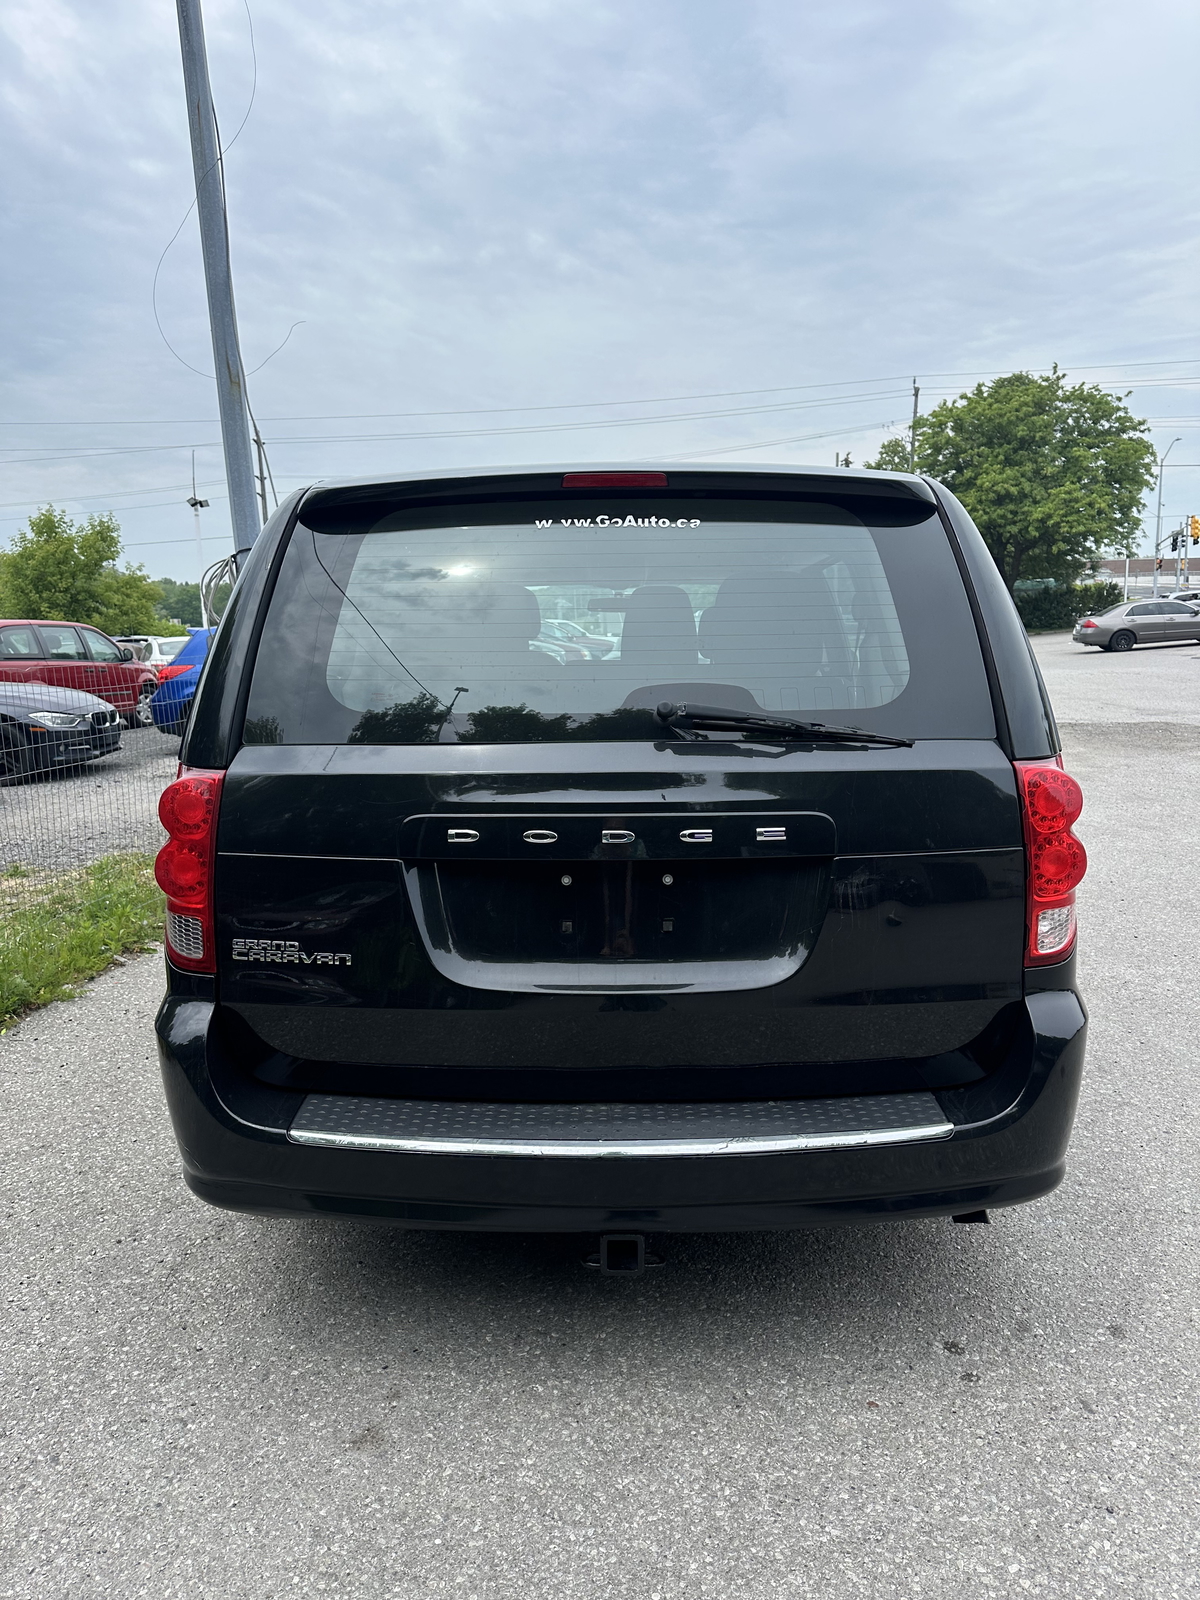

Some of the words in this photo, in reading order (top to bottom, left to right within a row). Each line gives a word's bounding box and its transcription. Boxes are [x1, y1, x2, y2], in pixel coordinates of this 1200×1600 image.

[447, 828, 787, 844] DODGE
[232, 938, 299, 951] GRAND
[232, 949, 352, 966] CARAVAN
